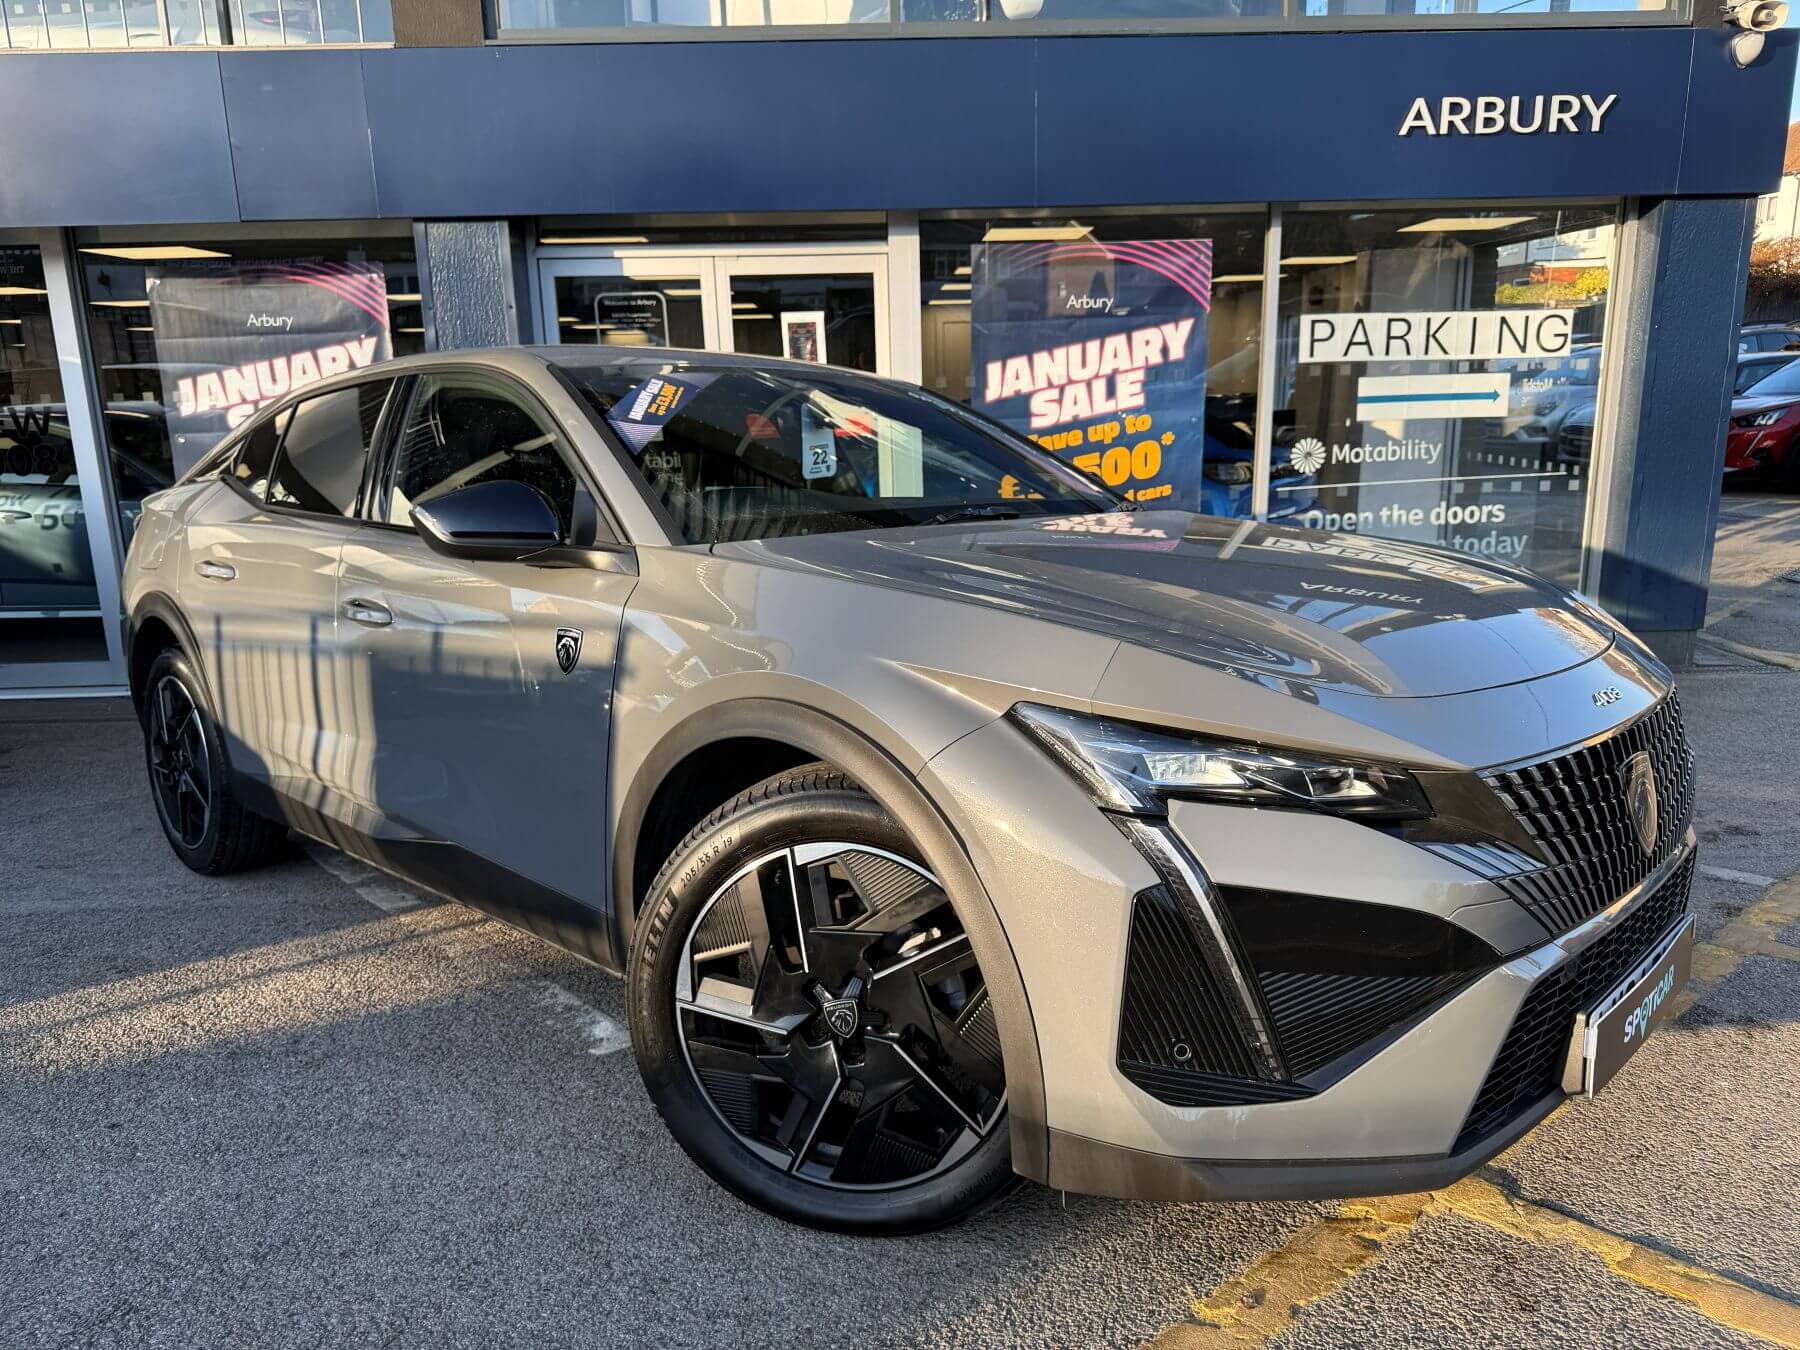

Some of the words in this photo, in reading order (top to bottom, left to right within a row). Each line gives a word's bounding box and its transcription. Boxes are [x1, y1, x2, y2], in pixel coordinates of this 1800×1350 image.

[1398, 93, 1617, 137] ARBURY
[1066, 294, 1114, 313] Arbury
[247, 313, 293, 331] Arbury
[1309, 313, 1569, 358] PARKING
[985, 318, 1196, 404] JANUARY
[177, 336, 378, 418] JANUARY
[1030, 368, 1146, 430] SALE
[1087, 420, 1121, 445] up
[1125, 413, 1153, 435] to
[812, 449, 829, 466] 22
[1332, 438, 1442, 466] Motability
[1136, 482, 1173, 503] cars
[1304, 509, 1374, 531] Open
[1379, 503, 1424, 528] the
[1430, 500, 1506, 526] doors
[1450, 530, 1529, 559] today
[723, 836, 733, 849] 19
